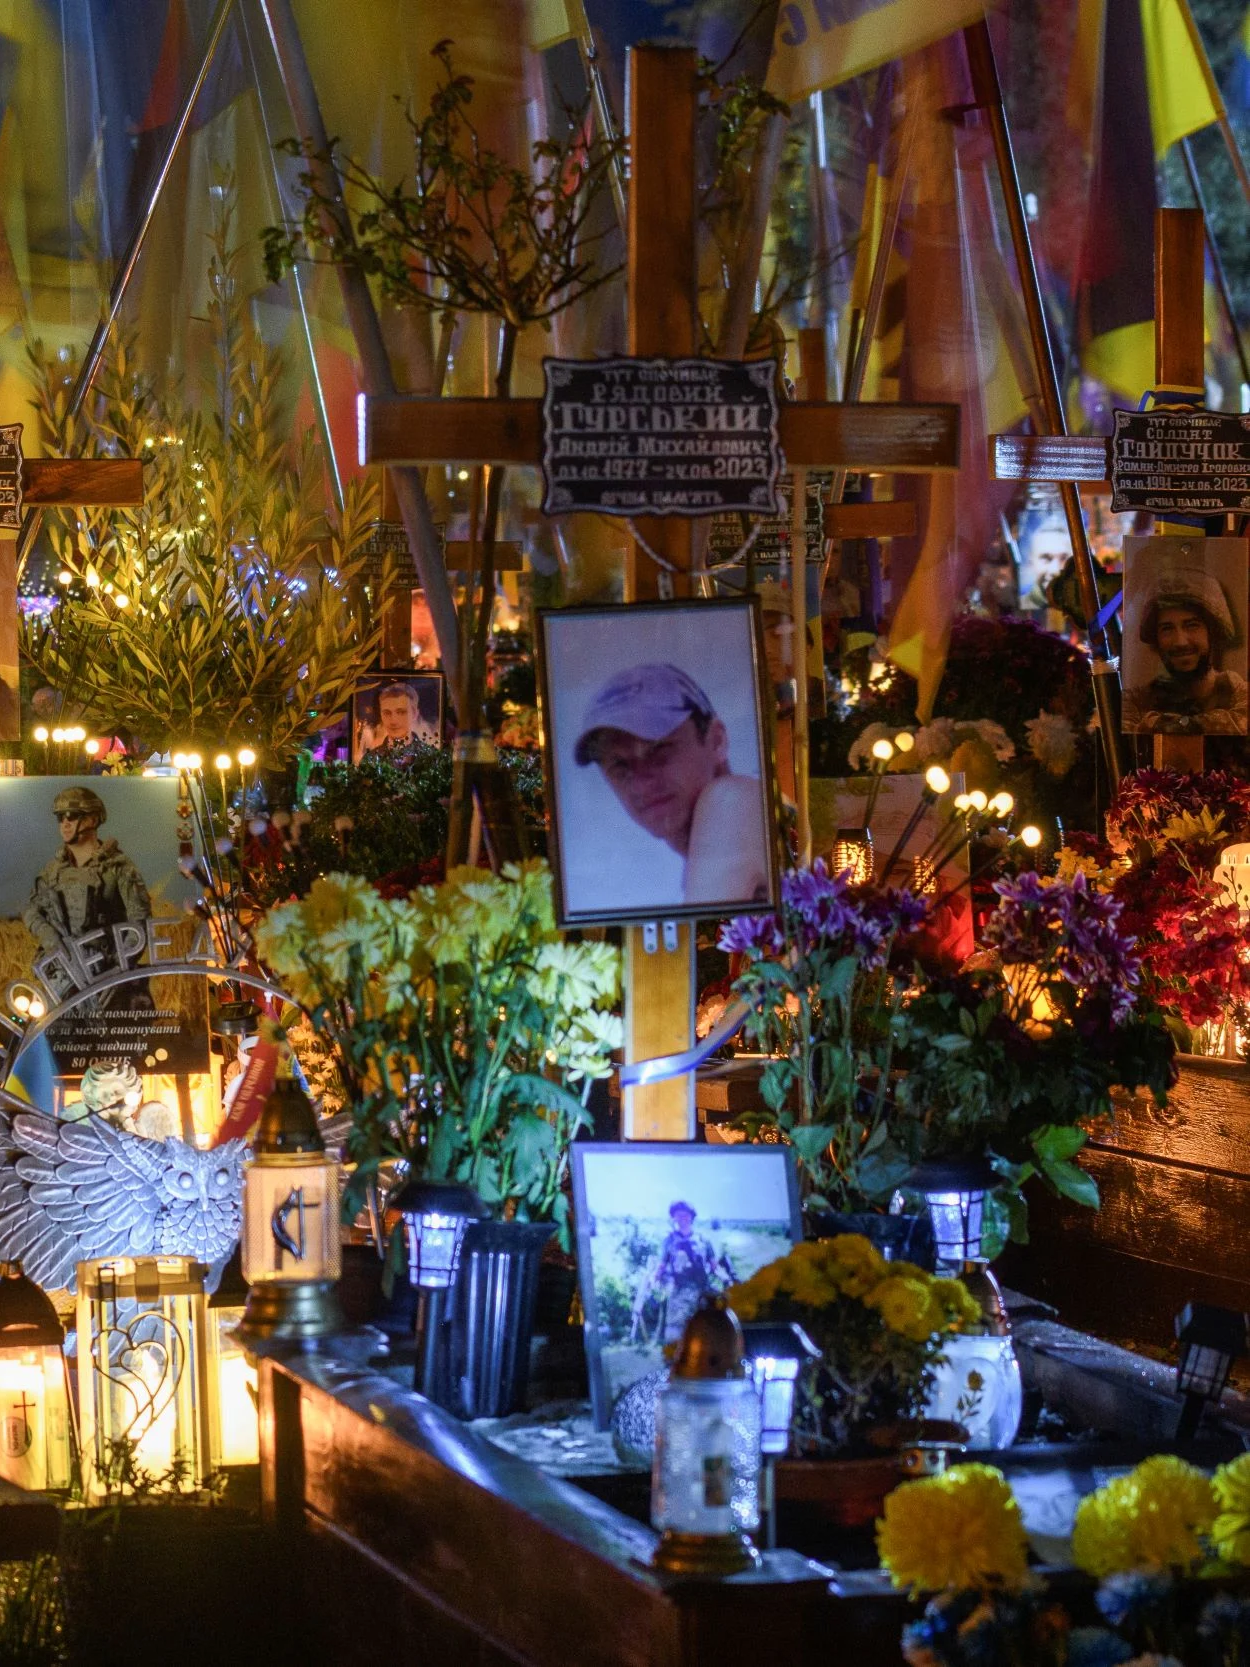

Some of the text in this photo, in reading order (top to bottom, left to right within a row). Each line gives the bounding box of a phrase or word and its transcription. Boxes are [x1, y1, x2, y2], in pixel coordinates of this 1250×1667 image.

[88, 1010, 102, 1018] не
[110, 1025, 181, 1037] виконувати
[53, 1040, 148, 1052] бойове завдання
[71, 1057, 86, 1068] 80
